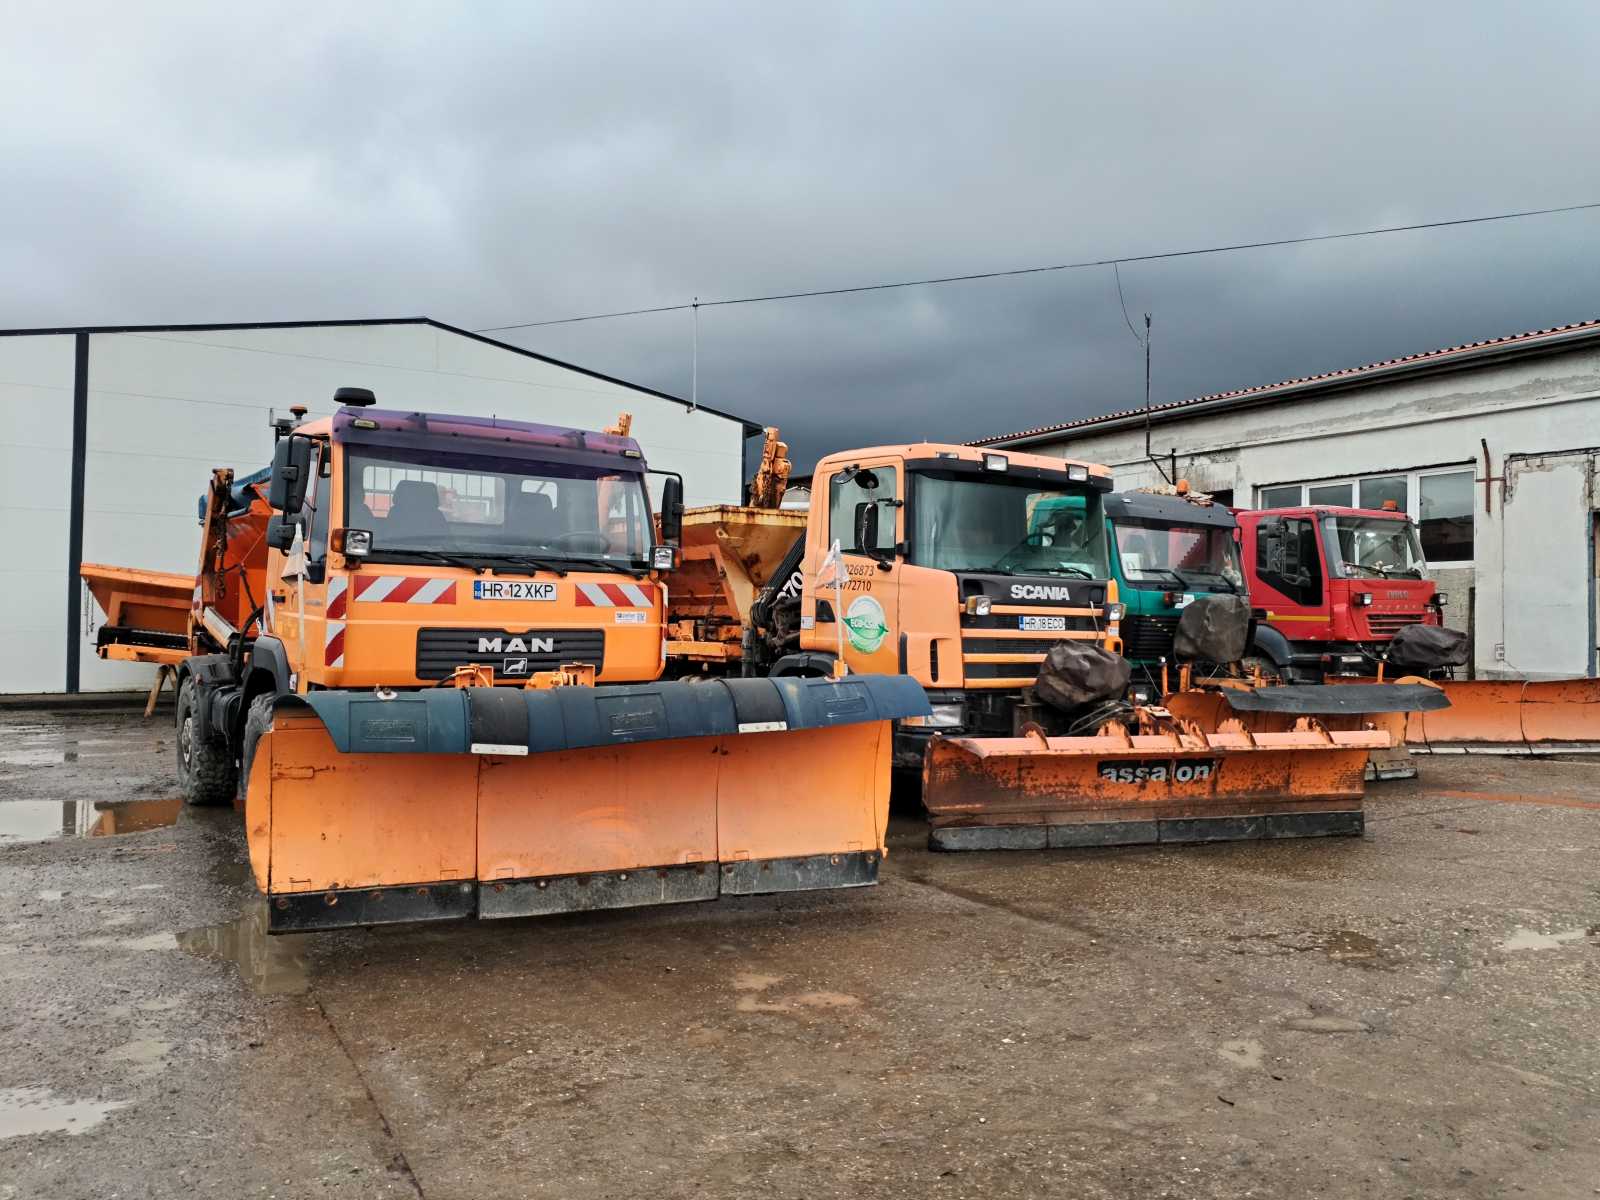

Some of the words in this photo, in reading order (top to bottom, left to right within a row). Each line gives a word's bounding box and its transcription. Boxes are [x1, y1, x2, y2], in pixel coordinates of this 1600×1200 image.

[482, 582, 503, 598] HR
[508, 583, 522, 598] 12
[524, 583, 554, 599] XKP
[1010, 584, 1070, 601] SCANIA
[1024, 617, 1037, 629] HR
[1038, 618, 1047, 629] 18
[477, 637, 554, 653] MAN
